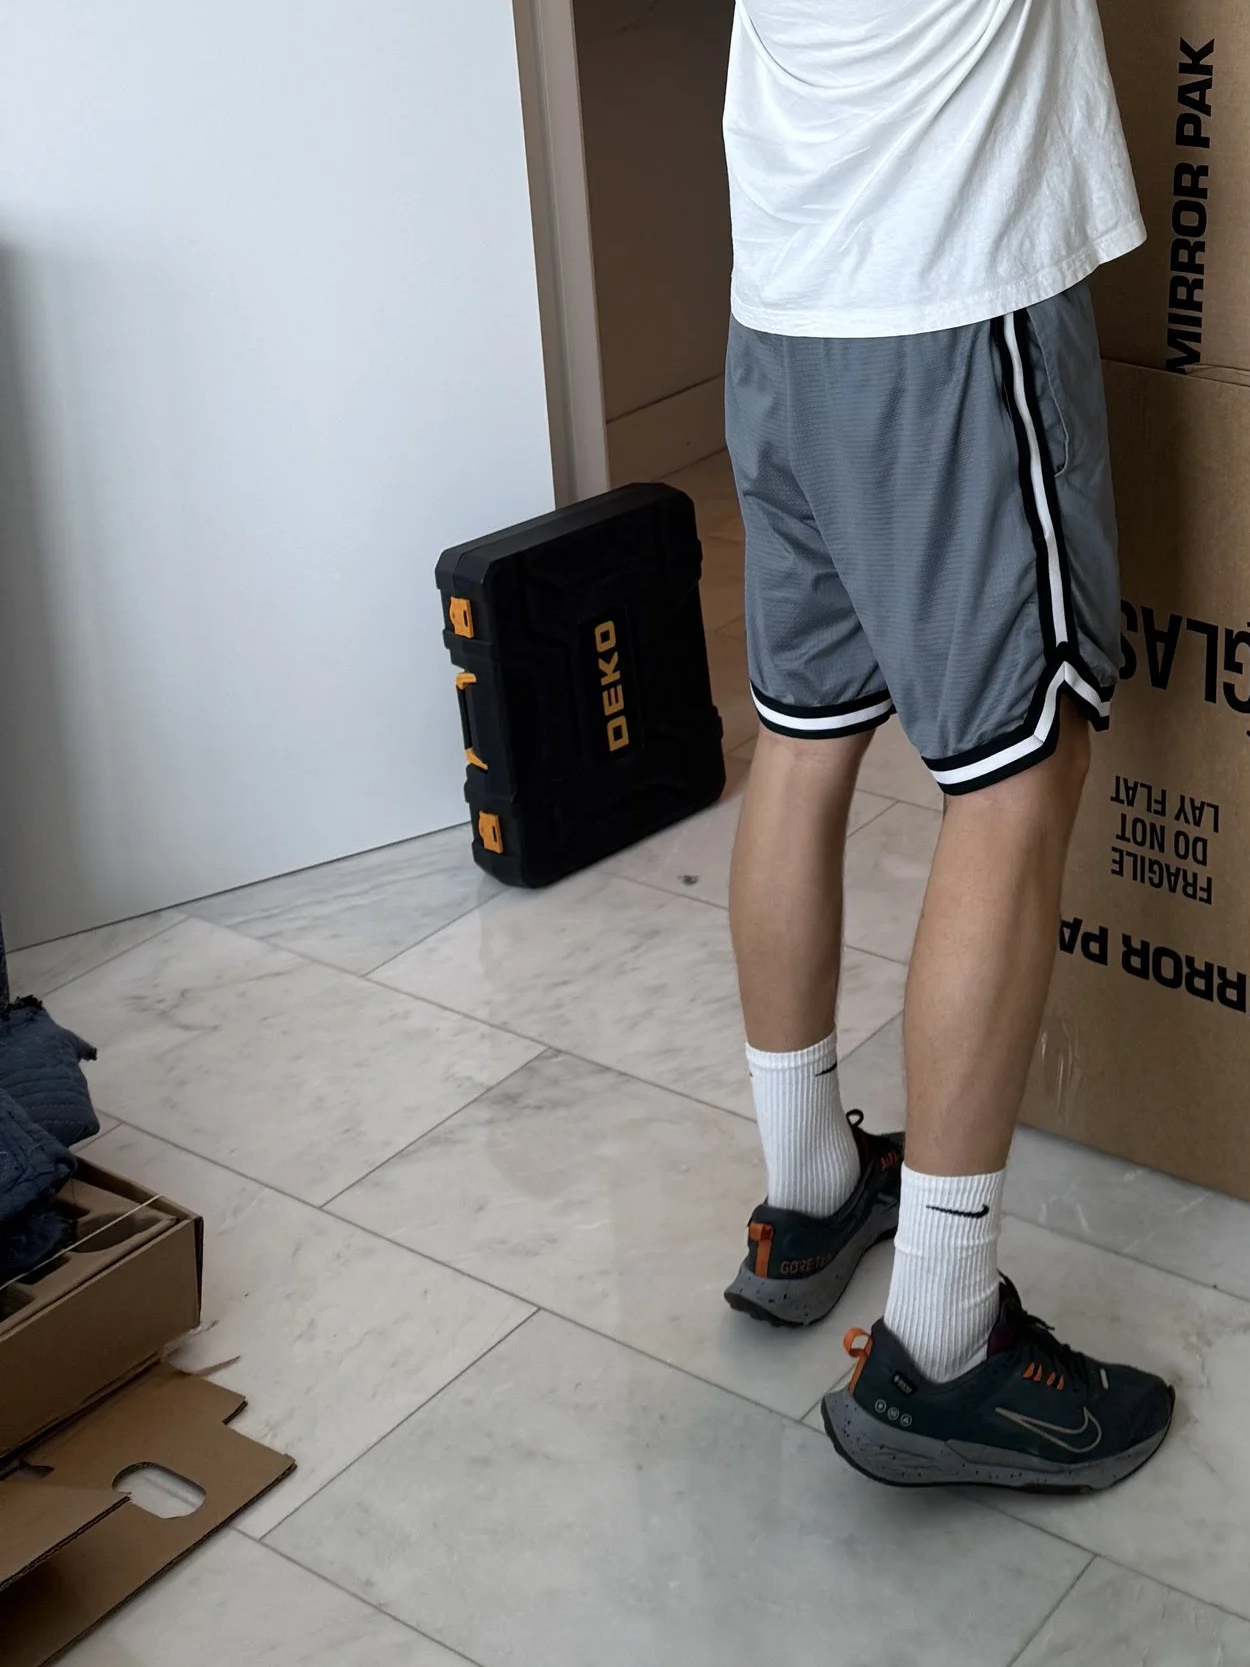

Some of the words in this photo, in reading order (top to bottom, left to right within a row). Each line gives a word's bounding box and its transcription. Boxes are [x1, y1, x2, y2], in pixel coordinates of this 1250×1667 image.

[1174, 37, 1216, 150] PAK
[1166, 161, 1210, 375] MIRROR
[594, 620, 629, 752] DEKO
[1110, 775, 1167, 816] FLAT
[1175, 794, 1220, 833] LAY
[1116, 813, 1166, 855] NOT
[1174, 830, 1208, 866] DO
[1111, 846, 1213, 905] FRAGILE
[1059, 917, 1109, 966] PA
